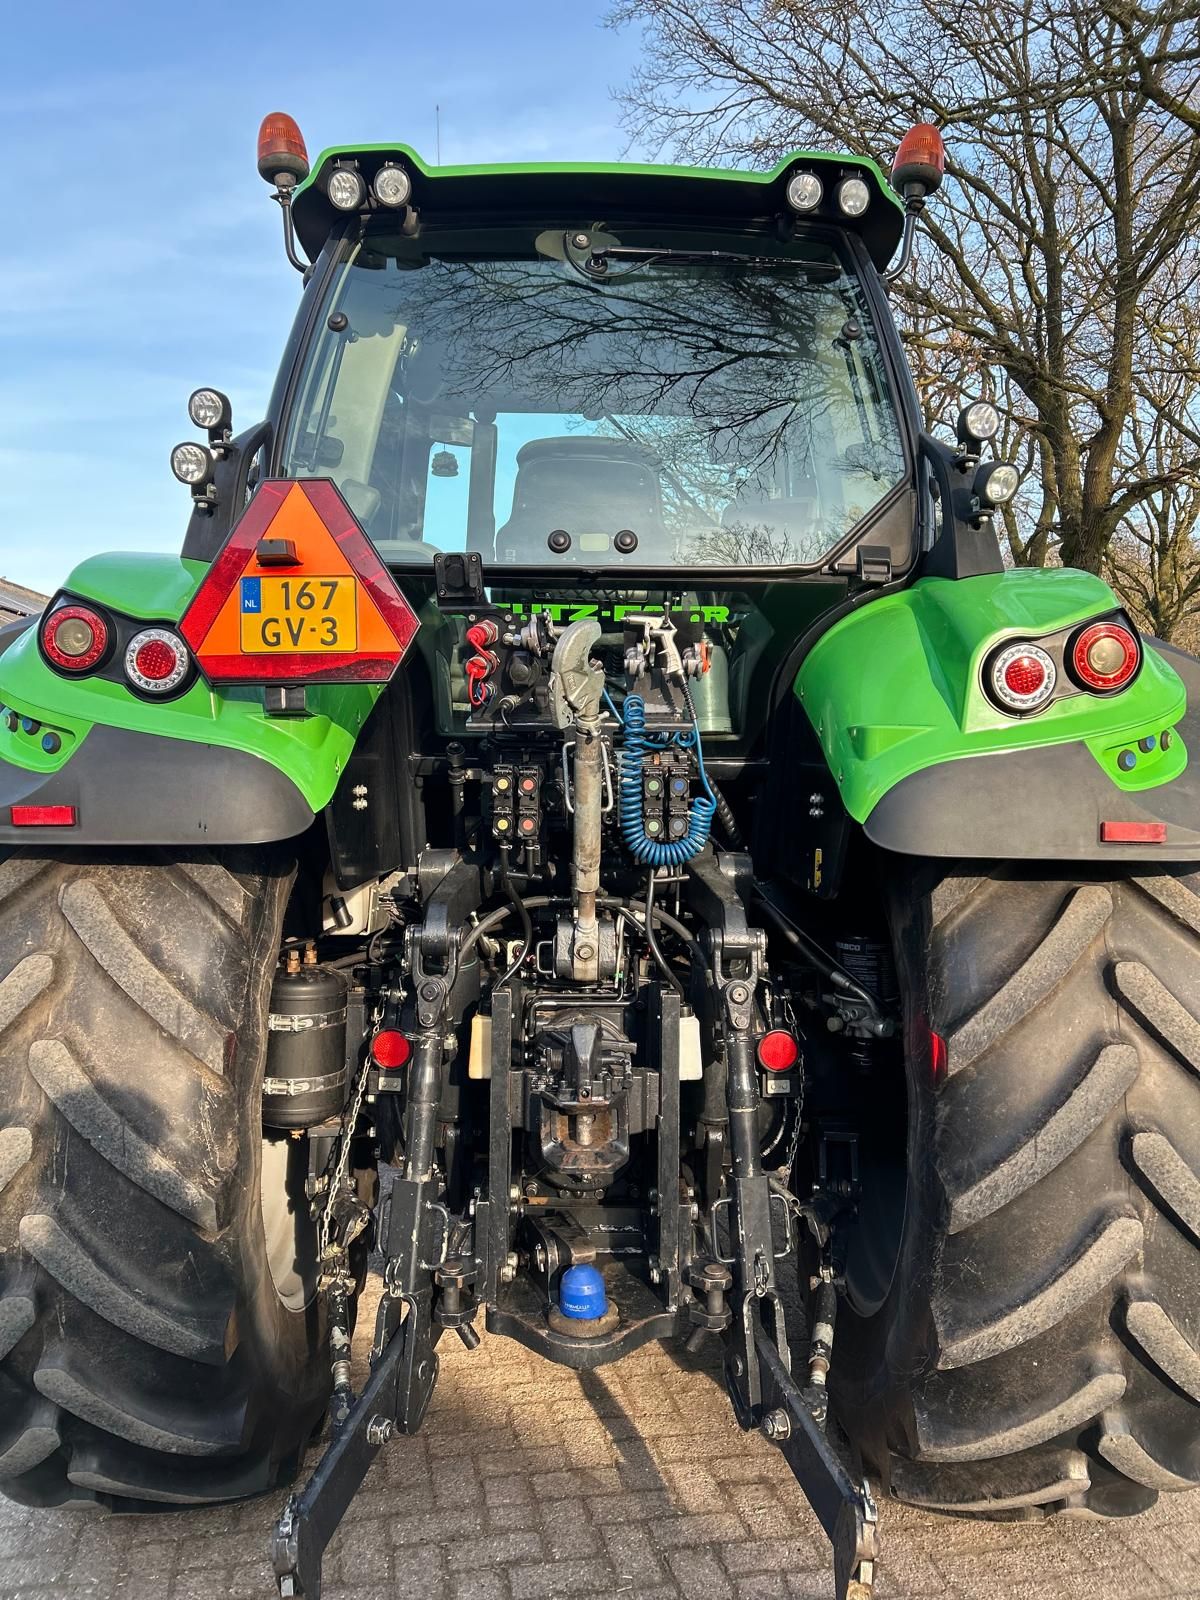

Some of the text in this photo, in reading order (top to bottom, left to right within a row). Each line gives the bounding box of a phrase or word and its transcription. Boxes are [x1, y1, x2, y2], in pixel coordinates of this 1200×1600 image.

[244, 599, 258, 609] NL
[281, 581, 339, 611] 167
[261, 616, 339, 648] GV-3
